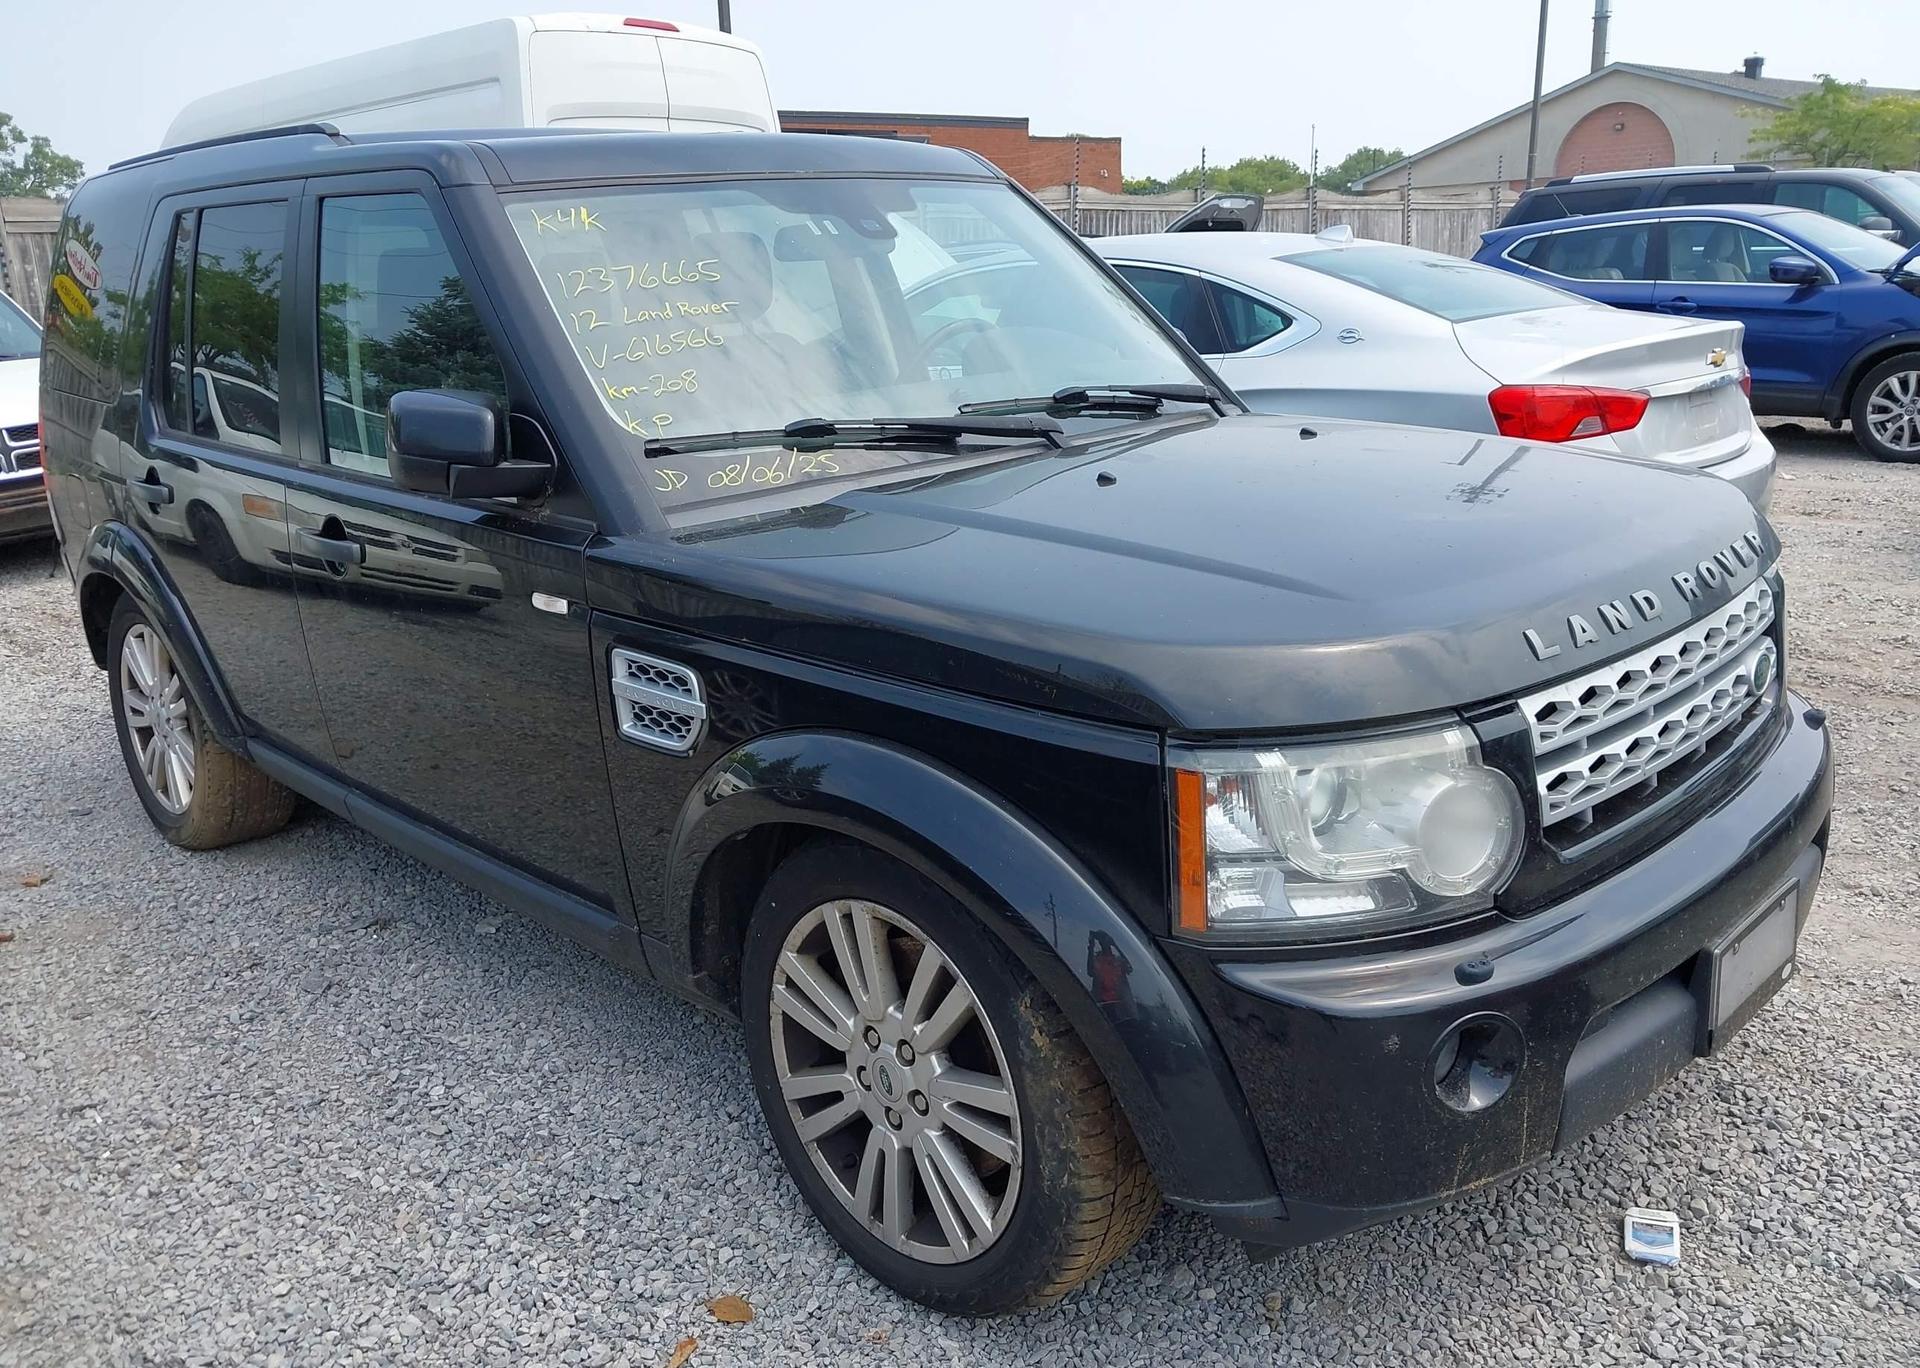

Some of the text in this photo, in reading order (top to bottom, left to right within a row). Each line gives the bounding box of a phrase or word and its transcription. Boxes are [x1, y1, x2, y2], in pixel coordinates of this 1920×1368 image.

[557, 259, 721, 299] 12376665
[571, 301, 740, 334] 12 Land Rover
[655, 447, 840, 491] JD 08/06/25
[1522, 530, 1765, 661] LAND ROVER
